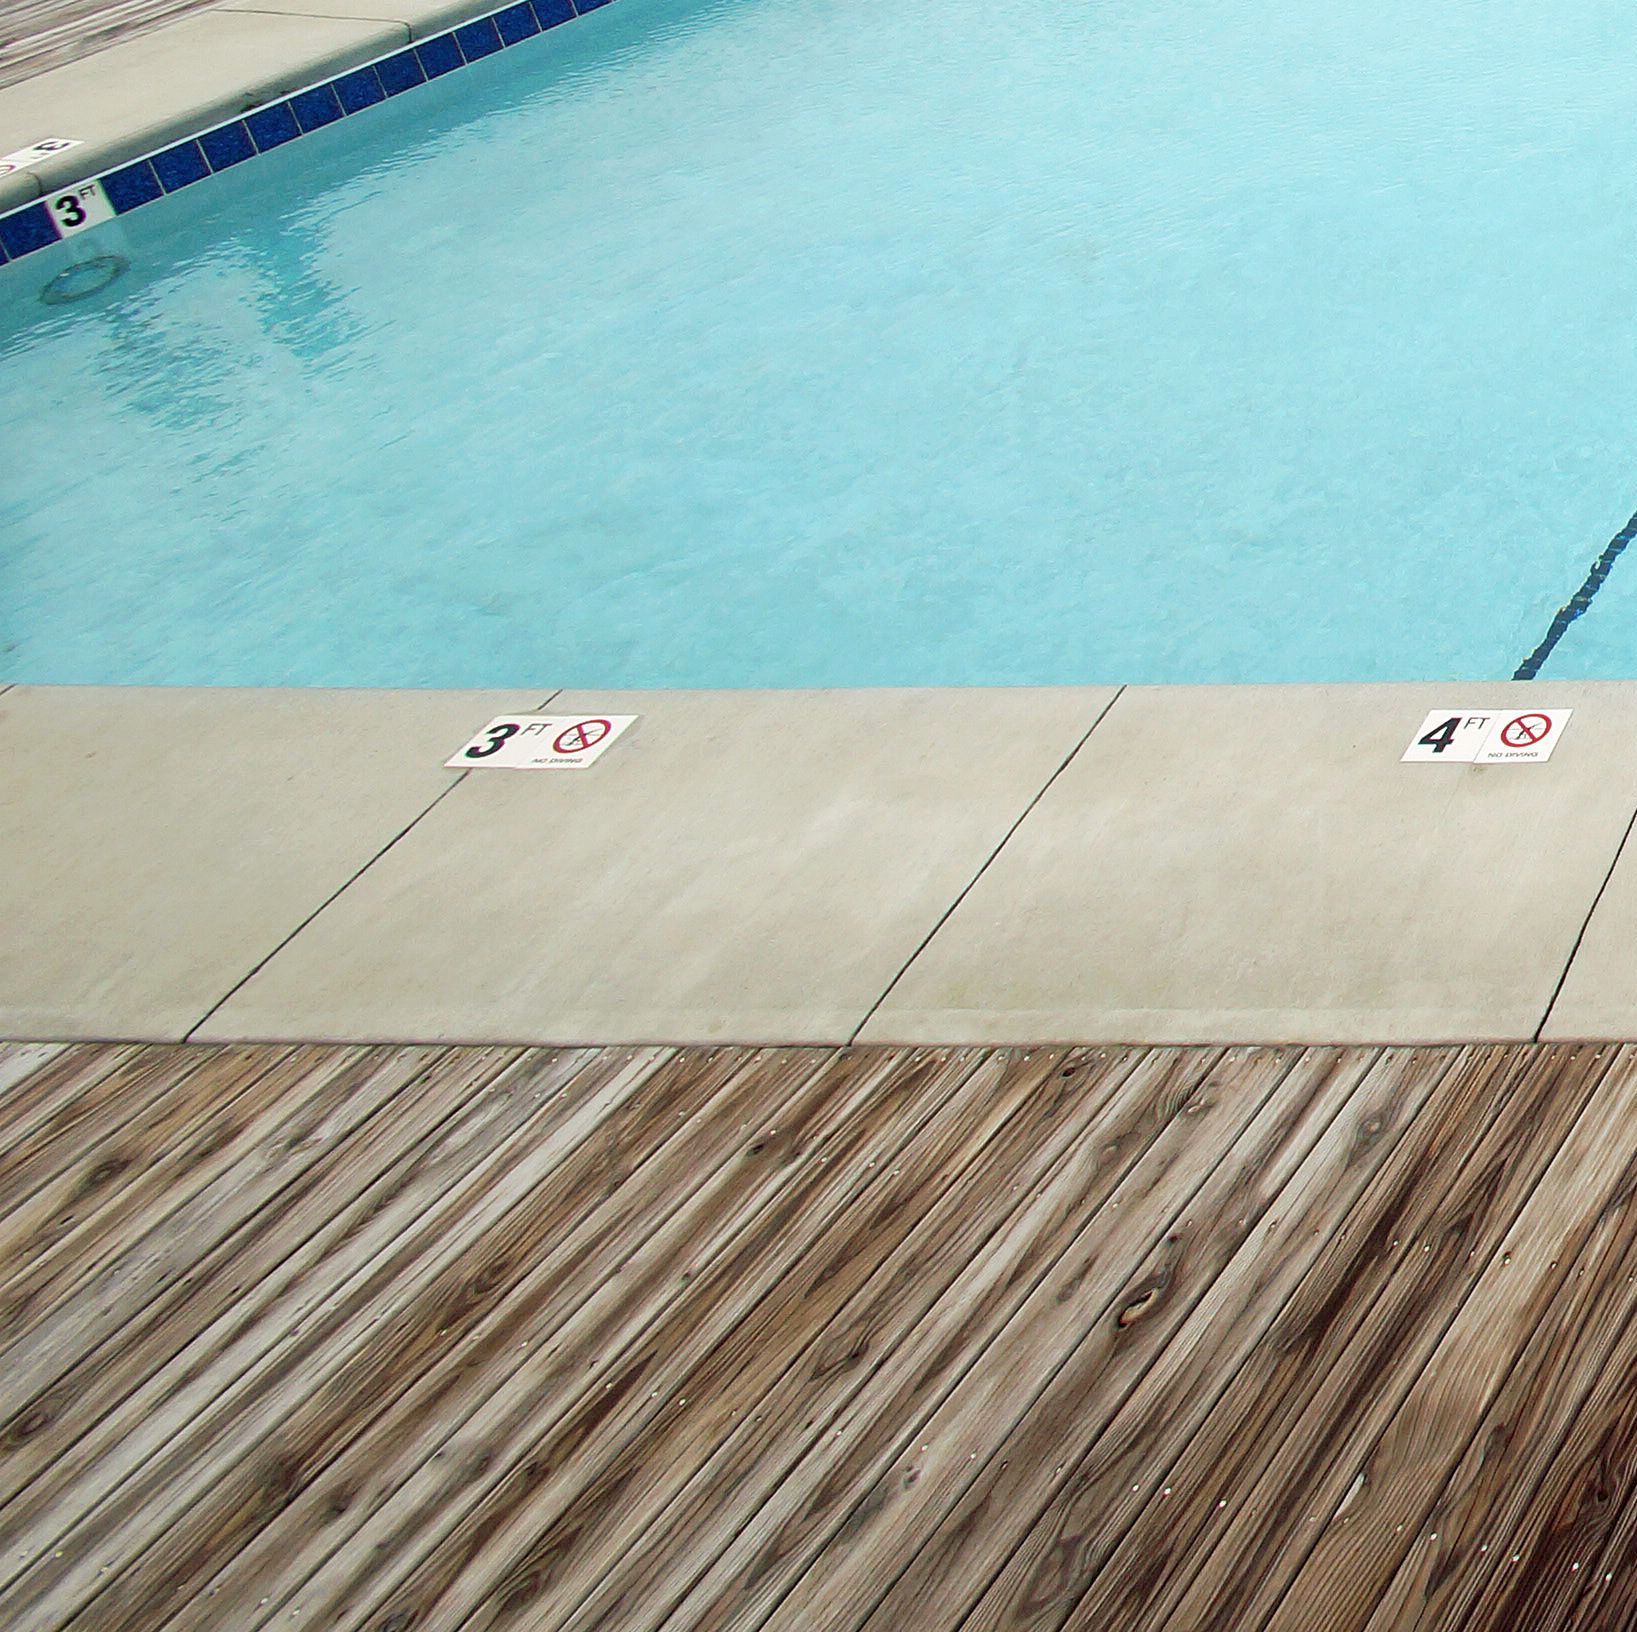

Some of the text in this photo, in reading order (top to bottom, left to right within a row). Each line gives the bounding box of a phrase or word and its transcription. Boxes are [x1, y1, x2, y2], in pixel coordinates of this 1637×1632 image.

[55, 184, 96, 227] 3 FT
[464, 723, 553, 759] 3 FT
[1418, 716, 1491, 753] 4 FT
